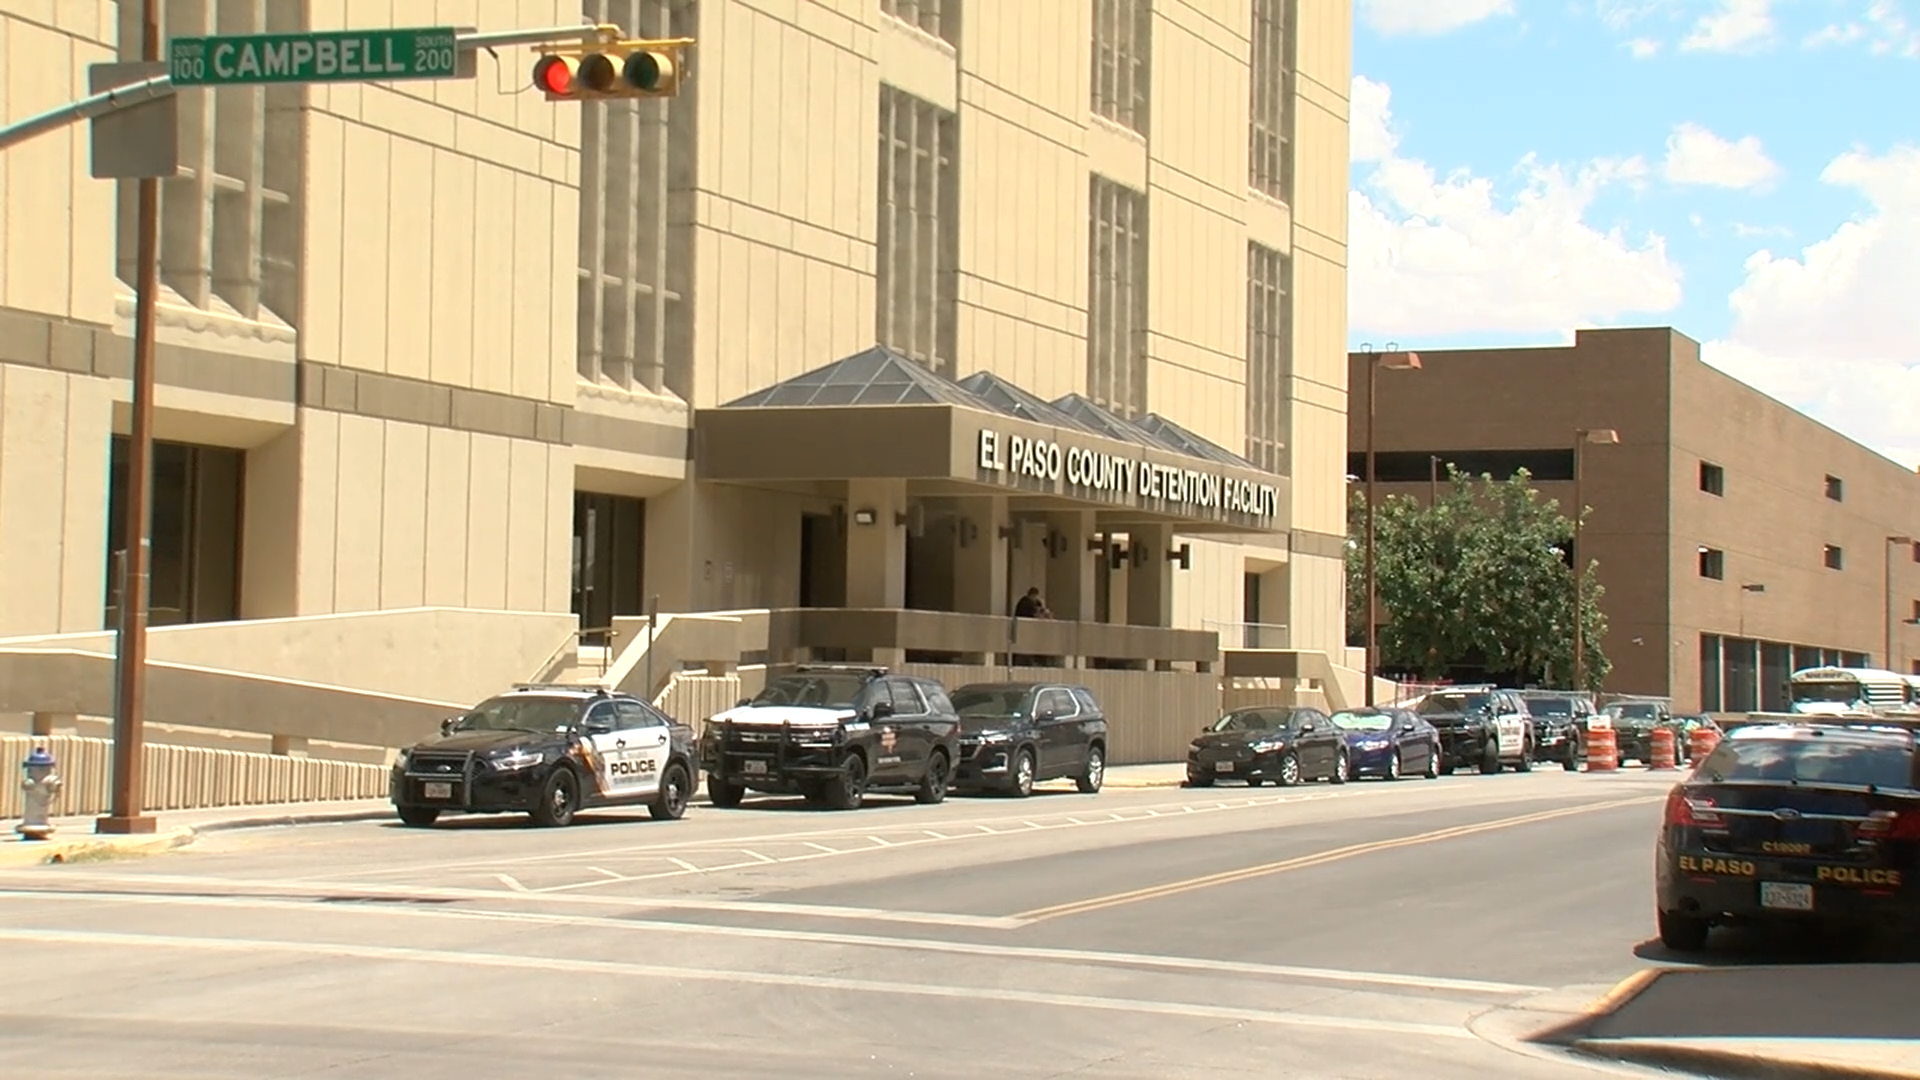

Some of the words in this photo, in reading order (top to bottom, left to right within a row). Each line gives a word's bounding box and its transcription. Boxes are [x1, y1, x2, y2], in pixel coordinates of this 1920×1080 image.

[416, 35, 453, 48] SOUTH
[174, 58, 205, 79] 100
[214, 38, 405, 78] CAMPBELL
[415, 49, 452, 72] 200
[980, 429, 1004, 470] EL
[1011, 435, 1061, 480] PASO
[1067, 446, 1136, 493] COUNTY
[1140, 461, 1220, 507] DETENTION
[1224, 477, 1280, 517] FACILITY
[611, 759, 656, 776] POLICE
[1679, 855, 1698, 872] EL
[1702, 858, 1756, 876] PASO
[1817, 866, 1902, 886] POLICE
